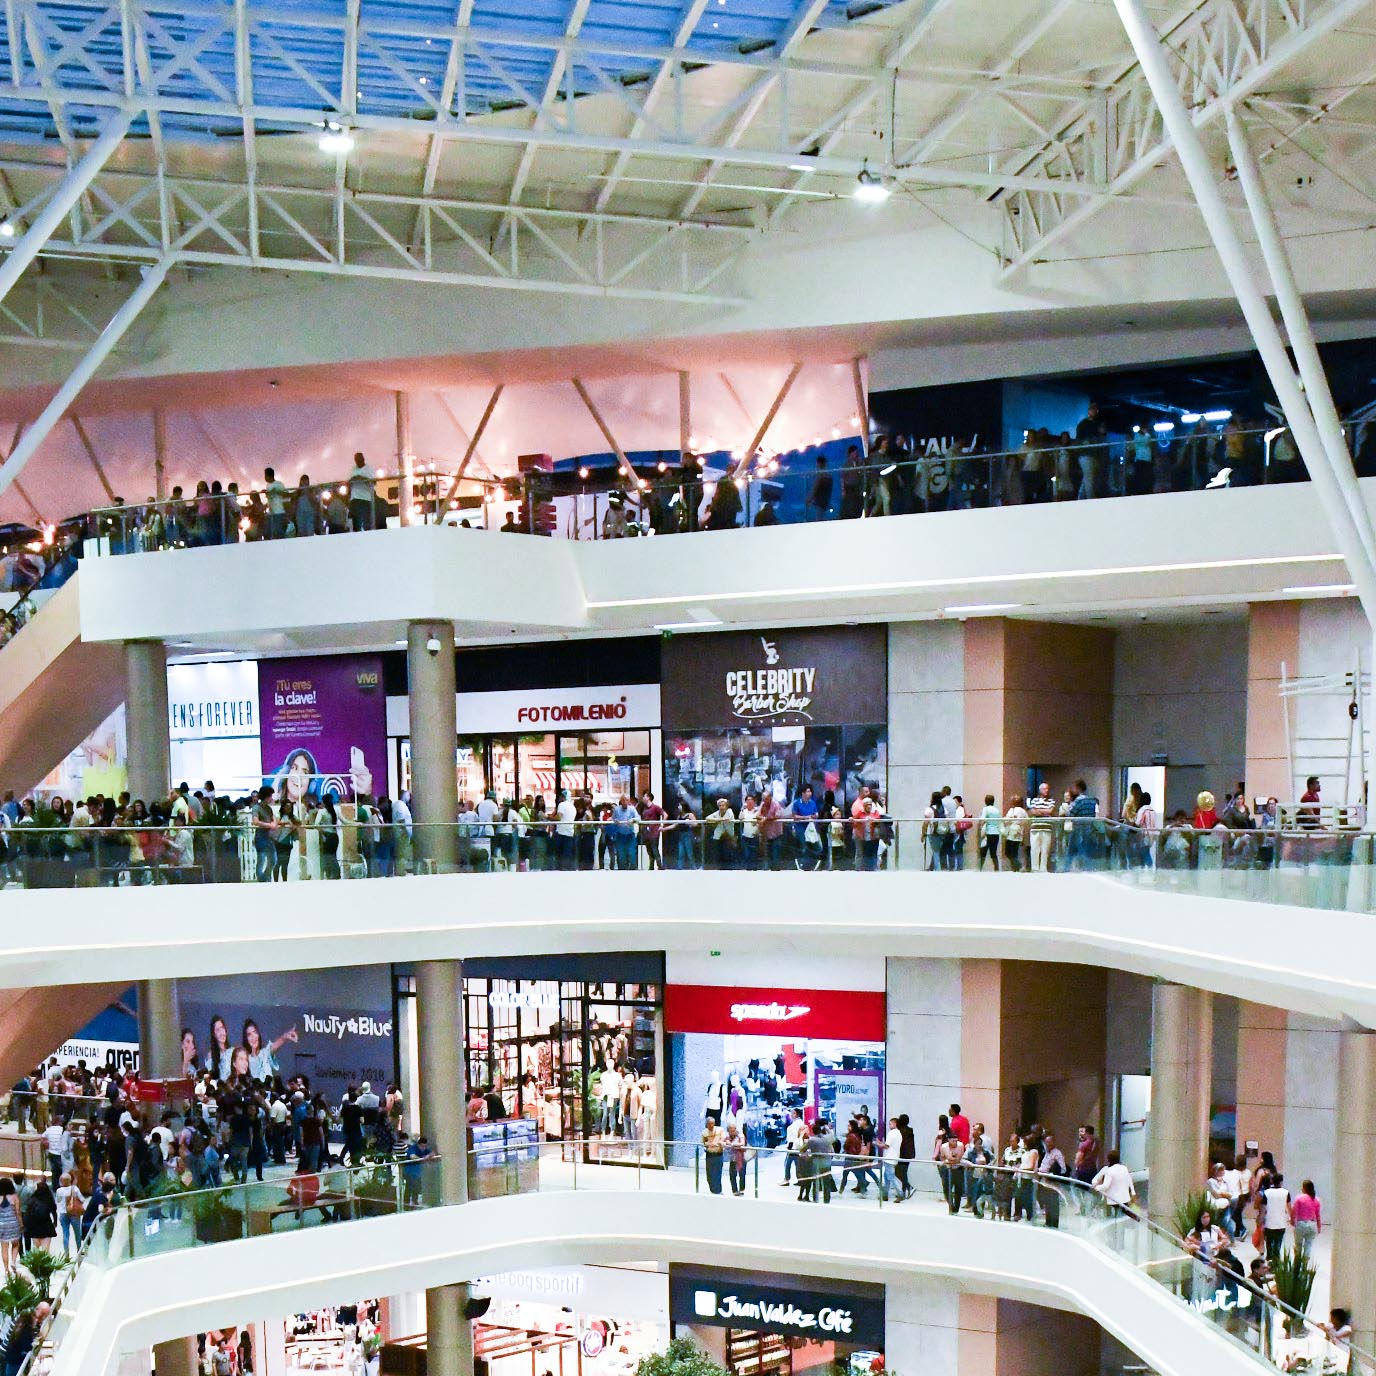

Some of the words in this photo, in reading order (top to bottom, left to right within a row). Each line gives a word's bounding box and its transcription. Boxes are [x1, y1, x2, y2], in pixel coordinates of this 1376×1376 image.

[726, 667, 816, 696] CELEBRITY
[275, 692, 284, 706] la
[286, 691, 317, 706] clave!
[169, 702, 194, 728] ENS
[199, 700, 253, 727] FOREVER
[517, 704, 627, 722] FOTOMILENIO
[359, 1016, 392, 1037] Blue
[718, 1296, 760, 1320] Juan
[760, 1301, 817, 1328] Valdez
[819, 1307, 852, 1333] Café
